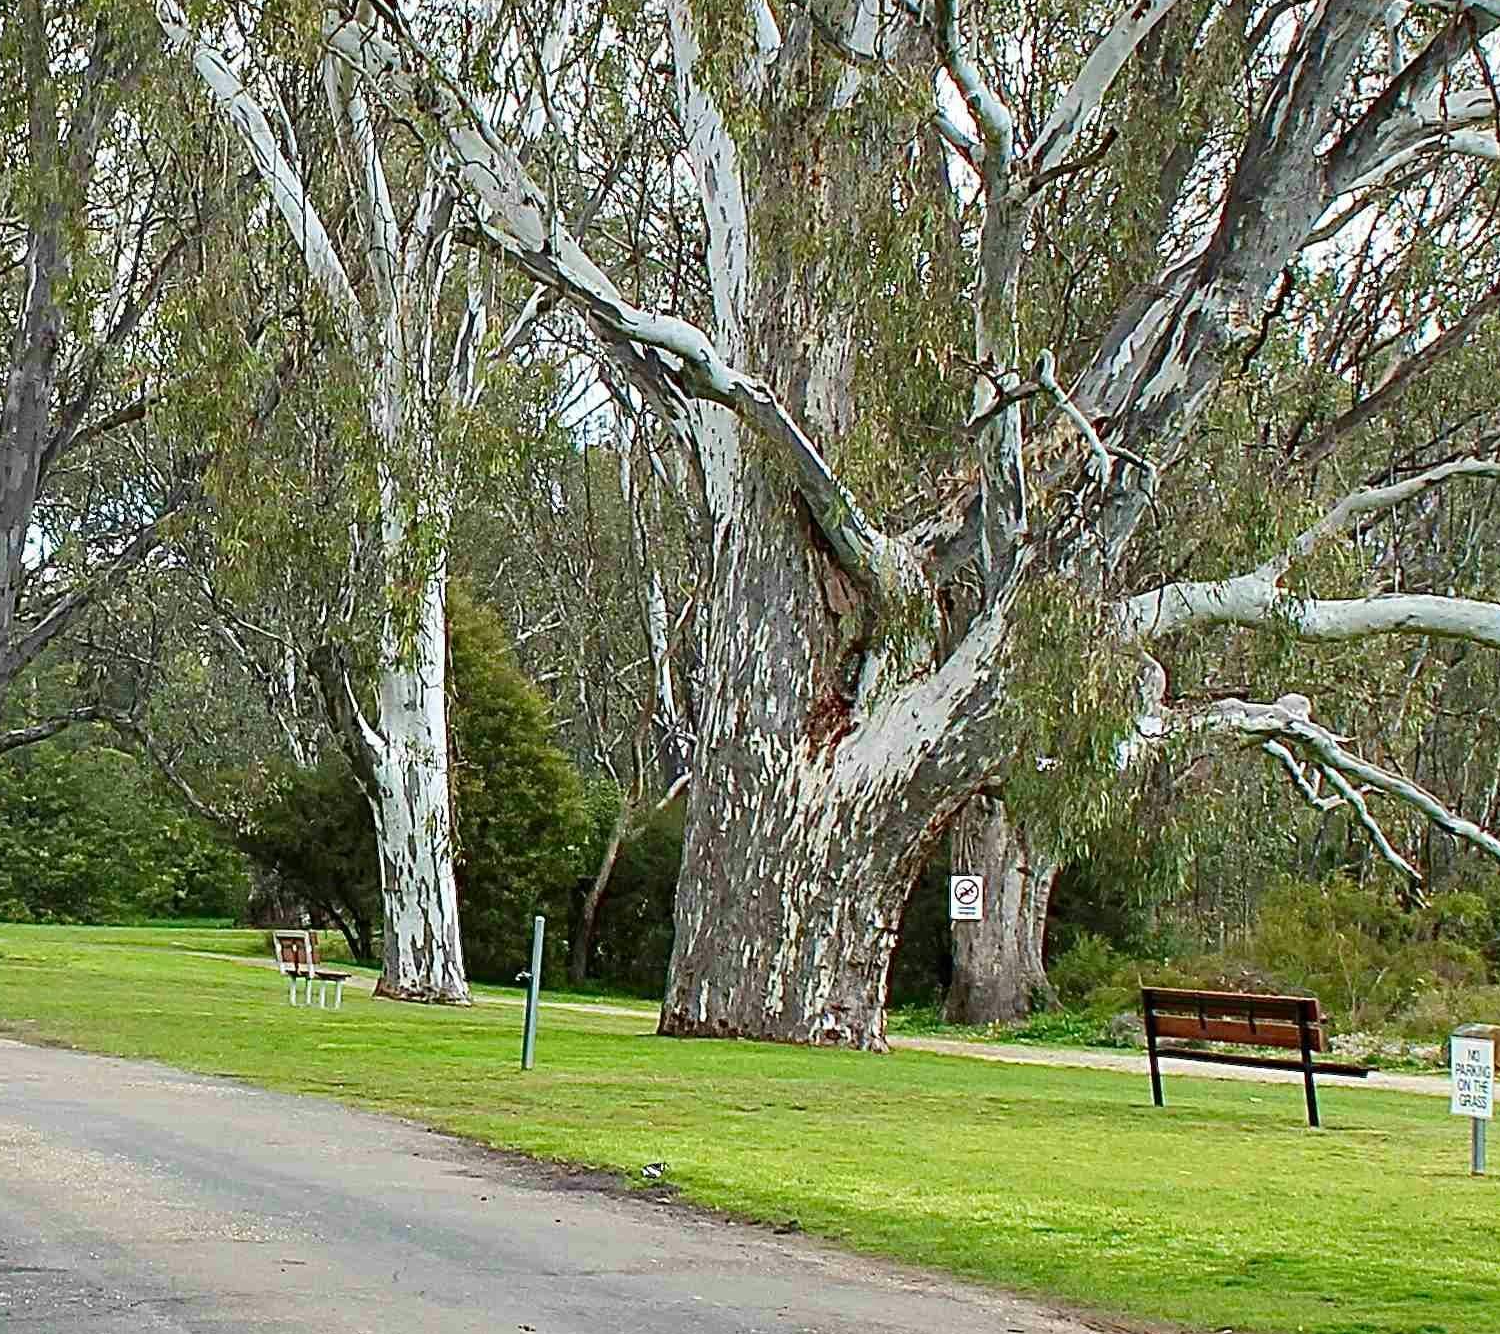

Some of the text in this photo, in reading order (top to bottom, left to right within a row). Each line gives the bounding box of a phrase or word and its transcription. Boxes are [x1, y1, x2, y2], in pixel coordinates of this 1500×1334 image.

[1467, 1049, 1480, 1062] NO
[1456, 1063, 1491, 1078] PARKING
[1458, 1078, 1488, 1094] ON THE
[1458, 1093, 1487, 1109] GRASS
